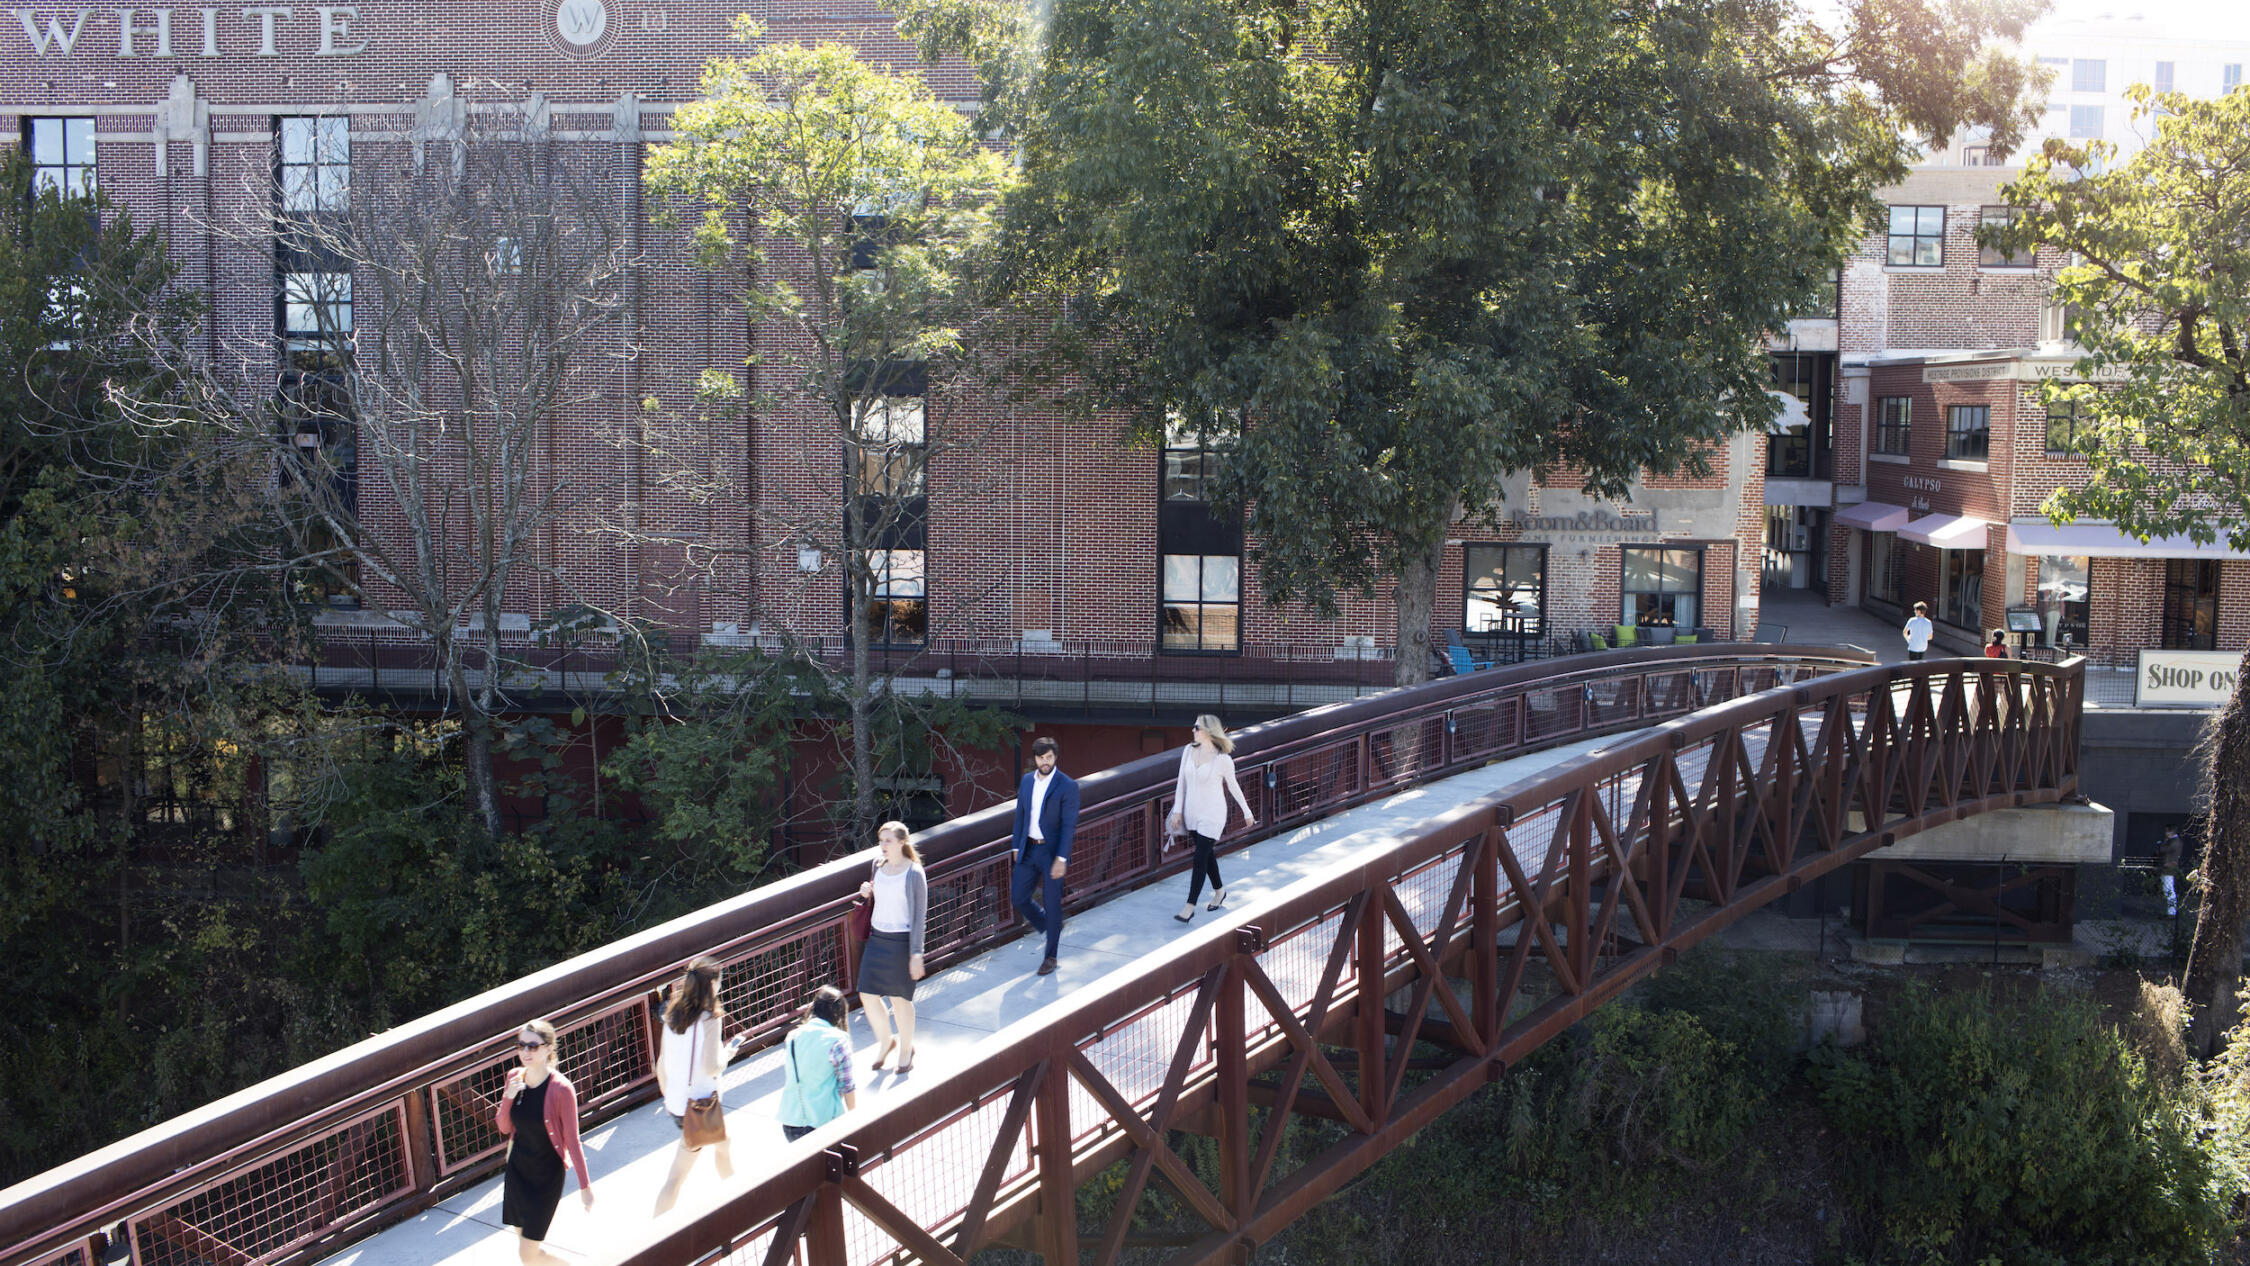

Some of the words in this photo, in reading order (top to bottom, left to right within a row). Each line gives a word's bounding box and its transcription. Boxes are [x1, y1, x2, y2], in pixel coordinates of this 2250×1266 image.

[14, 7, 370, 58] WHITE
[1981, 366, 2005, 377] DISTRICT
[1904, 475, 1941, 492] CALYPSO
[2147, 663, 2204, 689] SHOP
